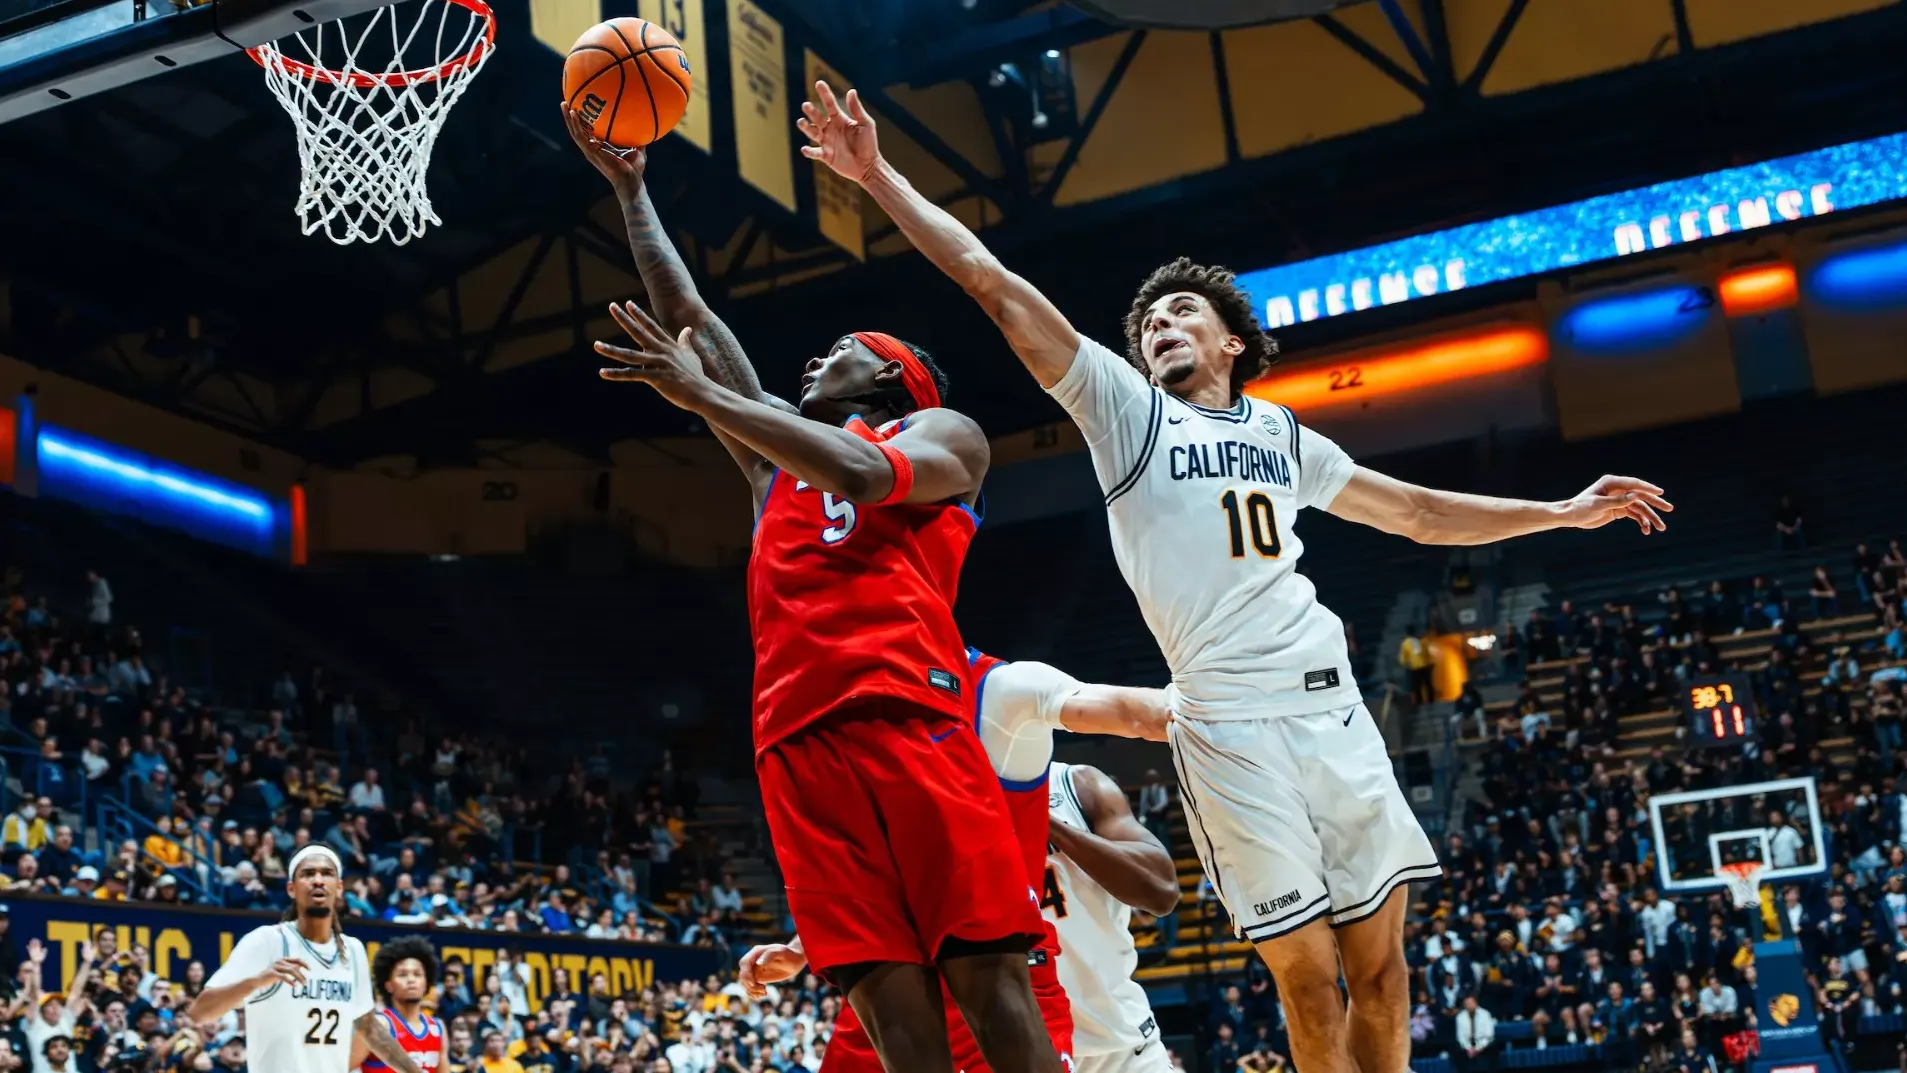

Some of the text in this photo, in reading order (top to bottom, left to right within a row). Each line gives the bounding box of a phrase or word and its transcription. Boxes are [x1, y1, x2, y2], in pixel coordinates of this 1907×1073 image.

[1328, 369, 1363, 391] 22
[1170, 440, 1292, 490] CALIFORNIA
[822, 490, 856, 544] 5
[1220, 489, 1282, 561] 10
[1713, 707, 1746, 738] 11
[1041, 864, 1069, 920] 4
[1253, 888, 1302, 916] CALIFORNIA
[305, 1007, 340, 1045] 22
